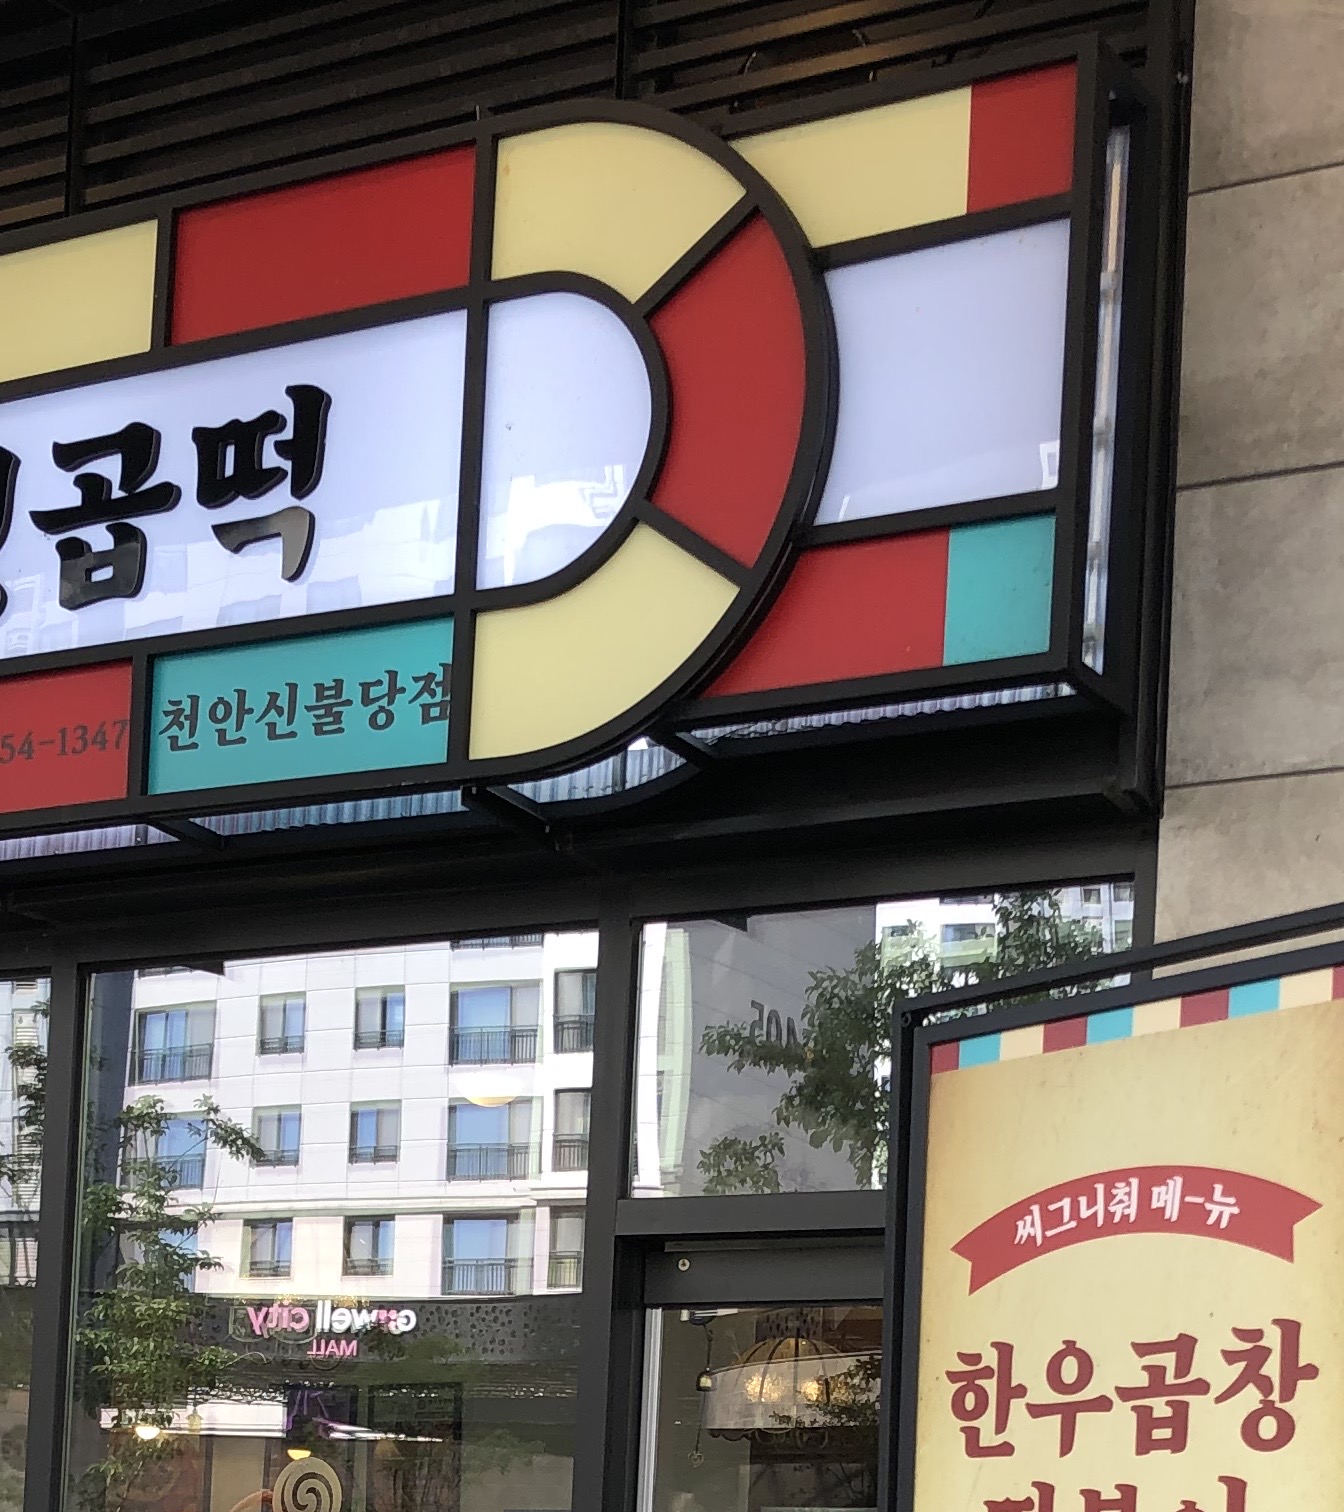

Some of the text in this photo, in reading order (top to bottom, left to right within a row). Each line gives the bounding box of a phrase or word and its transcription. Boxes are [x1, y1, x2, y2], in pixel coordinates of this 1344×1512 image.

[158, 662, 454, 755] 천안신불당점
[1014, 1177, 1139, 1249] 씨그니춰
[945, 1316, 1320, 1460] 한우곱창
